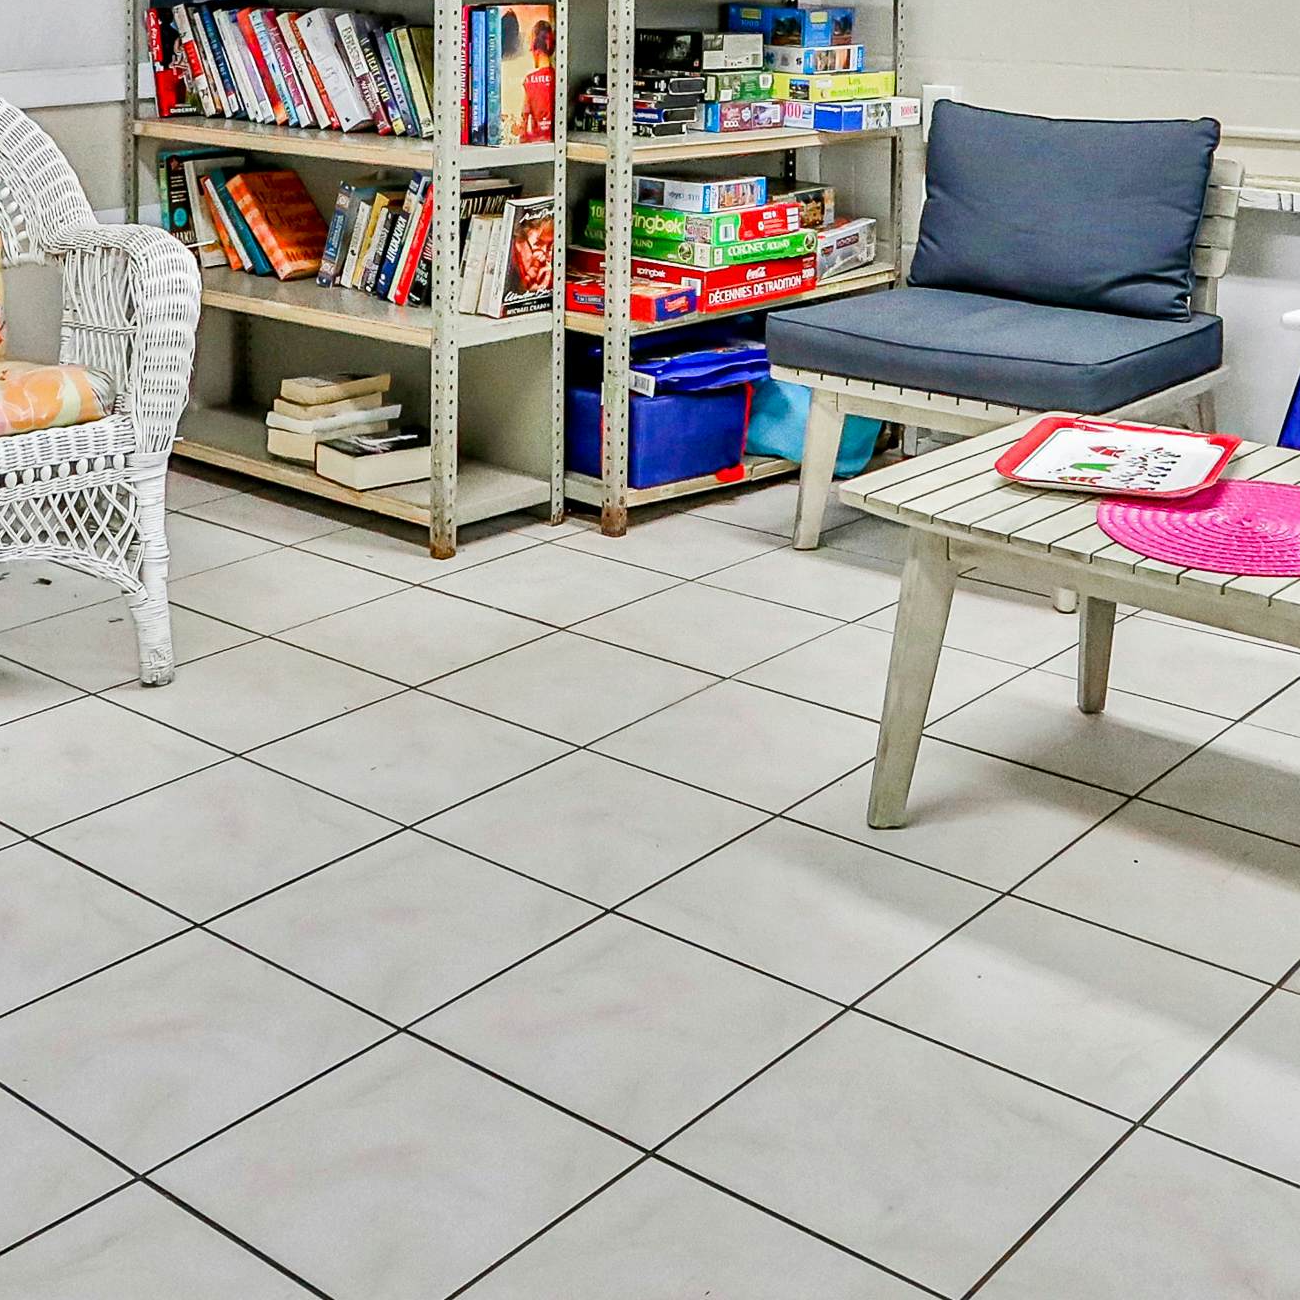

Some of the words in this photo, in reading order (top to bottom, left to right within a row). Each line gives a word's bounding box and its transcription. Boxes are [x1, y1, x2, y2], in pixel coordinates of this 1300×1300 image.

[386, 215, 407, 263] KNOCKOUT
[631, 214, 684, 235] ringbok
[708, 287, 752, 305] DÉCENNIES
[753, 283, 764, 295] DE
[765, 275, 802, 292] TRADITION
